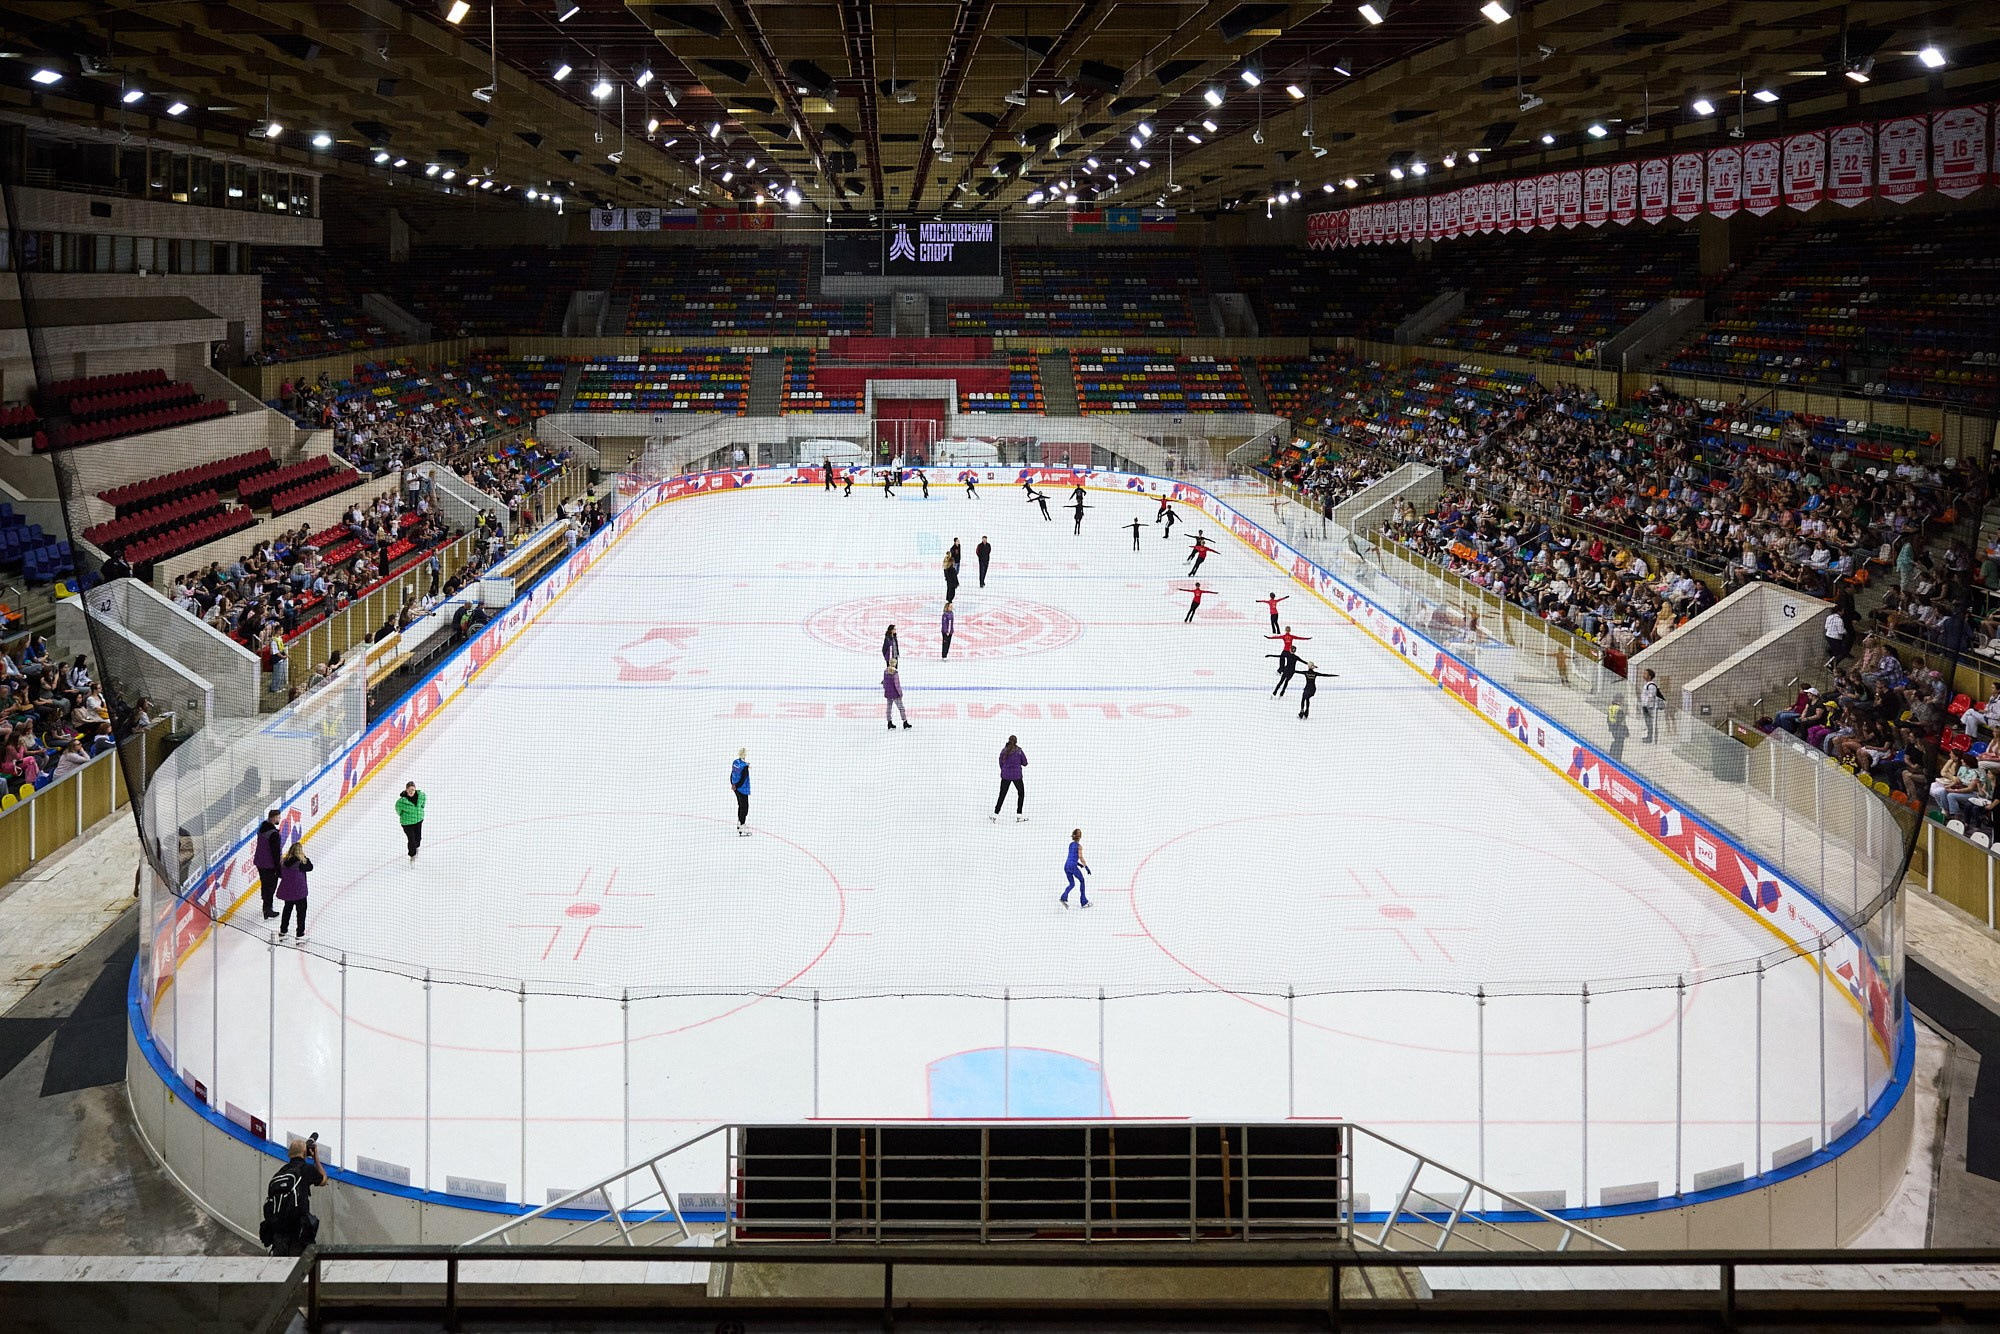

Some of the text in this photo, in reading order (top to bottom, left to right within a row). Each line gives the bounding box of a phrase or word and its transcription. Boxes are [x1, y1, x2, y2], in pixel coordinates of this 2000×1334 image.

[1952, 139, 1968, 157] 16
[1844, 154, 1859, 171] 22
[1898, 148, 1907, 165] 9
[1758, 167, 1764, 183] 5
[1797, 159, 1810, 177] 13
[1683, 177, 1692, 191] 14
[1720, 172, 1729, 187] 16
[920, 219, 993, 242] МОСКОВСКИЙ
[920, 243, 954, 262] СПОРТ
[100, 599, 112, 613] A2
[1783, 604, 1796, 618] C3
[714, 703, 1194, 719] OLIMPBET
